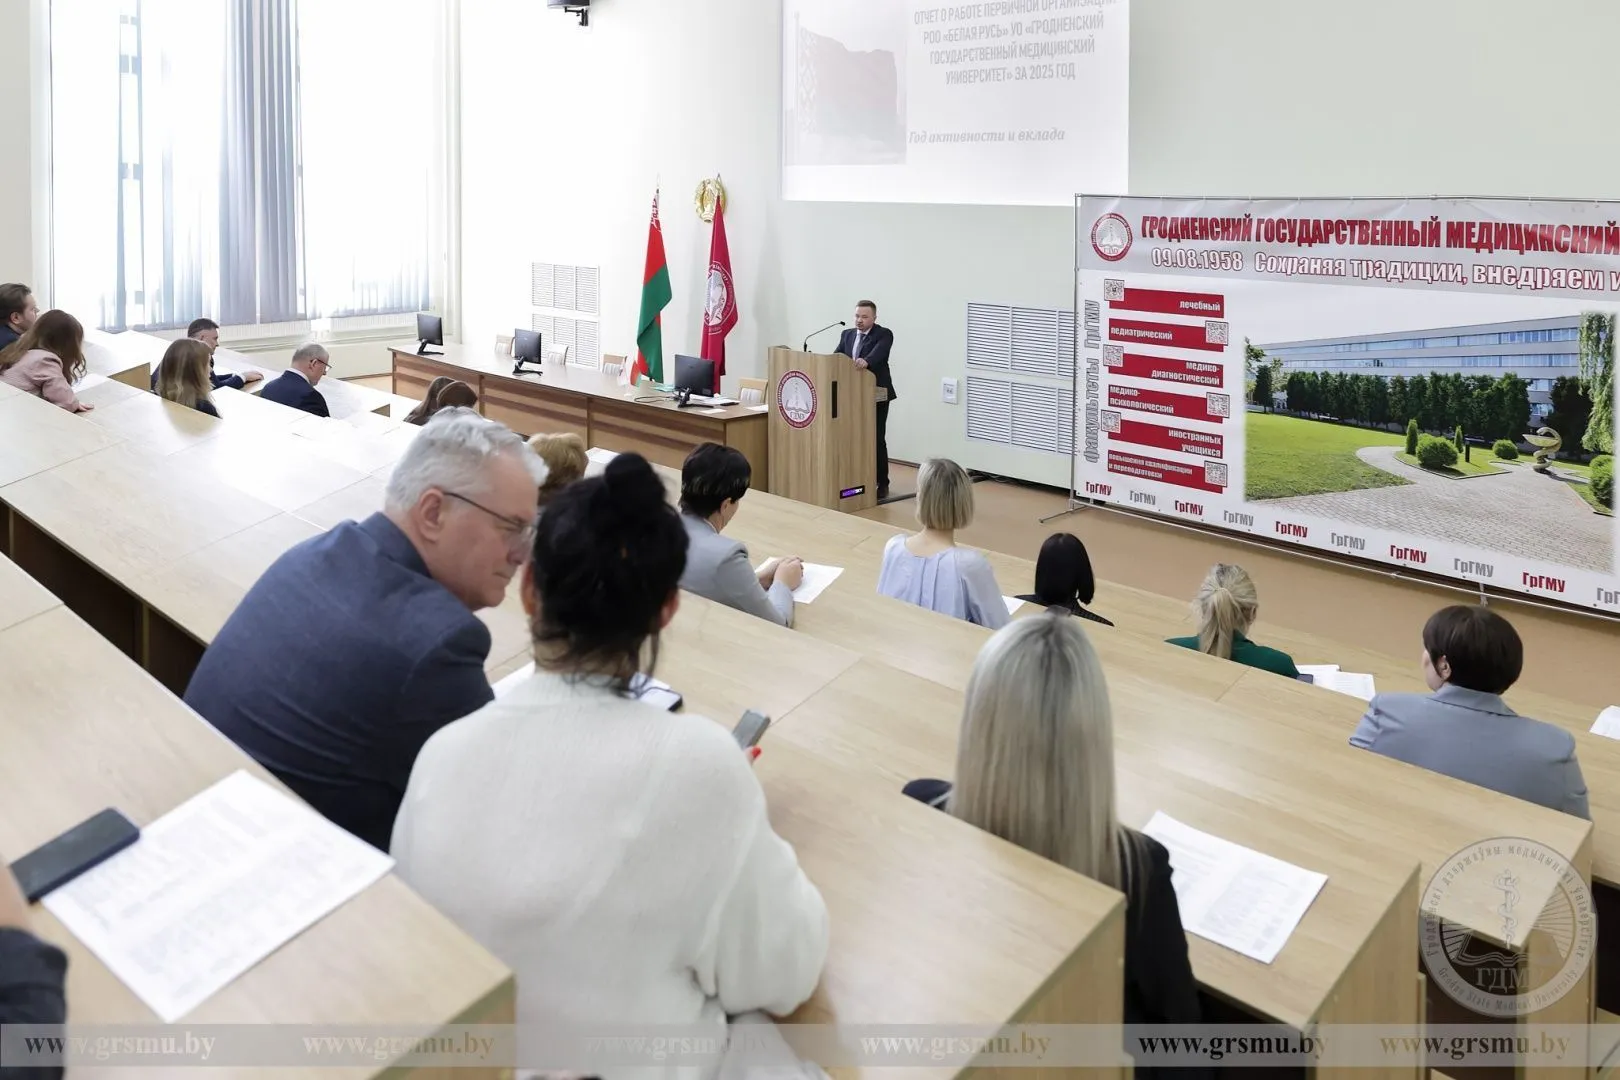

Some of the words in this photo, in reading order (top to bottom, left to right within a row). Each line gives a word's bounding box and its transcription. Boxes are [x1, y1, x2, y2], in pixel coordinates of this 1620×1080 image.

[914, 8, 939, 25] ОТЧЕТ
[941, 8, 947, 22] О
[948, 4, 982, 21] РАБОТЕ
[923, 30, 941, 44] РОО
[943, 26, 978, 43] «БЕЛАЯ
[979, 24, 1008, 40] РУСЬ»
[1011, 22, 1023, 36] УО
[1025, 10, 1104, 35] «ГРОДНЕНСКИЙ
[930, 41, 1018, 65] ГОСУДАРСТВЕННЫЙ
[1019, 35, 1095, 60] МЕДИЦИНСКИЙ
[946, 67, 1013, 85] УНИВЕРСИТЕТ»
[1014, 66, 1028, 81] ЗА
[1029, 64, 1054, 80] 2025
[1056, 62, 1076, 81] ГОД
[909, 131, 928, 144] Год
[929, 130, 1005, 144] активности
[1008, 130, 1015, 142] и
[1018, 126, 1066, 142] вклада
[1141, 213, 1252, 243] ГРОДНЕНСКИЙ
[1255, 215, 1441, 248] ГОСУДАРСТВЕННЫЙ
[1446, 220, 1620, 256] МЕДИЦИНСКИЙ
[1151, 247, 1244, 271] 09.08.1958
[1254, 251, 1347, 277] Сохраняя
[1350, 258, 1468, 286] традиции,
[1472, 263, 1605, 291] внедряем
[1179, 300, 1221, 311] лечебный
[1084, 299, 1101, 349] ГрГМУ
[1110, 326, 1173, 341] педиатрический
[1185, 361, 1220, 373] медико-
[1151, 369, 1220, 385] диагностический
[1109, 385, 1141, 397] медико-
[1083, 358, 1100, 464] факультеты
[1109, 398, 1174, 414] психологический
[1168, 429, 1222, 445] иностранных
[1181, 443, 1221, 458] учащихся
[1085, 481, 1112, 496] ГрГМУ
[1129, 490, 1156, 506] ГрГМУ
[1174, 500, 1204, 516] ГрГМУ
[1223, 510, 1254, 527] ГрГМУ
[1275, 521, 1308, 538] ГрГМУ
[1331, 532, 1366, 551] ГрГМУ
[1390, 544, 1427, 564] ГрГМУ
[1454, 557, 1494, 578] ГрГМУ
[1522, 572, 1566, 593] ГрГМУ
[1597, 587, 1620, 605] ГрГ
